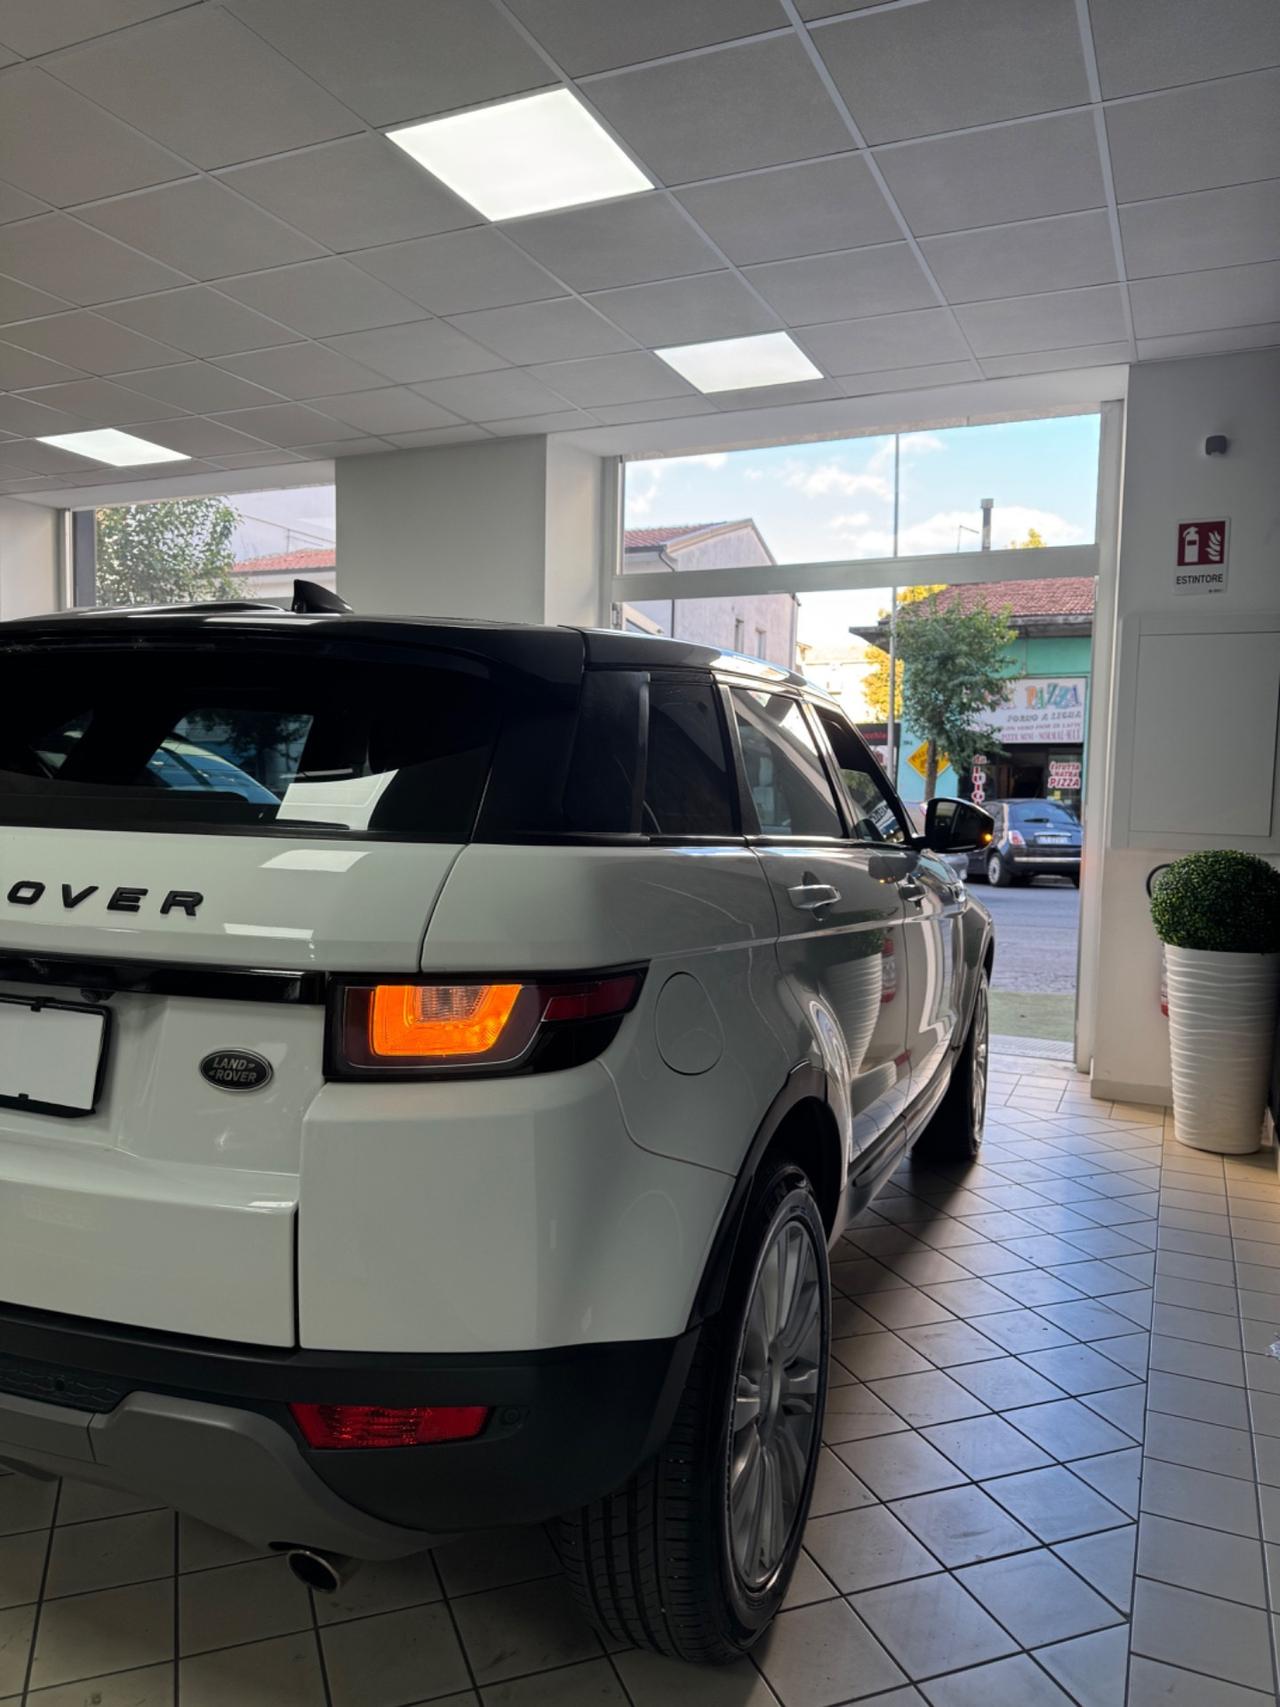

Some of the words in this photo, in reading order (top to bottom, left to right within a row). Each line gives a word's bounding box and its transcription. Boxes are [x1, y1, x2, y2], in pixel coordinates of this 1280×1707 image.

[1176, 573, 1223, 585] ESTINTORE
[1025, 682, 1082, 710] PAZZA
[1049, 777, 1080, 788] PIZZA
[212, 1057, 247, 1070] LAND
[215, 1069, 257, 1083] ROVER
